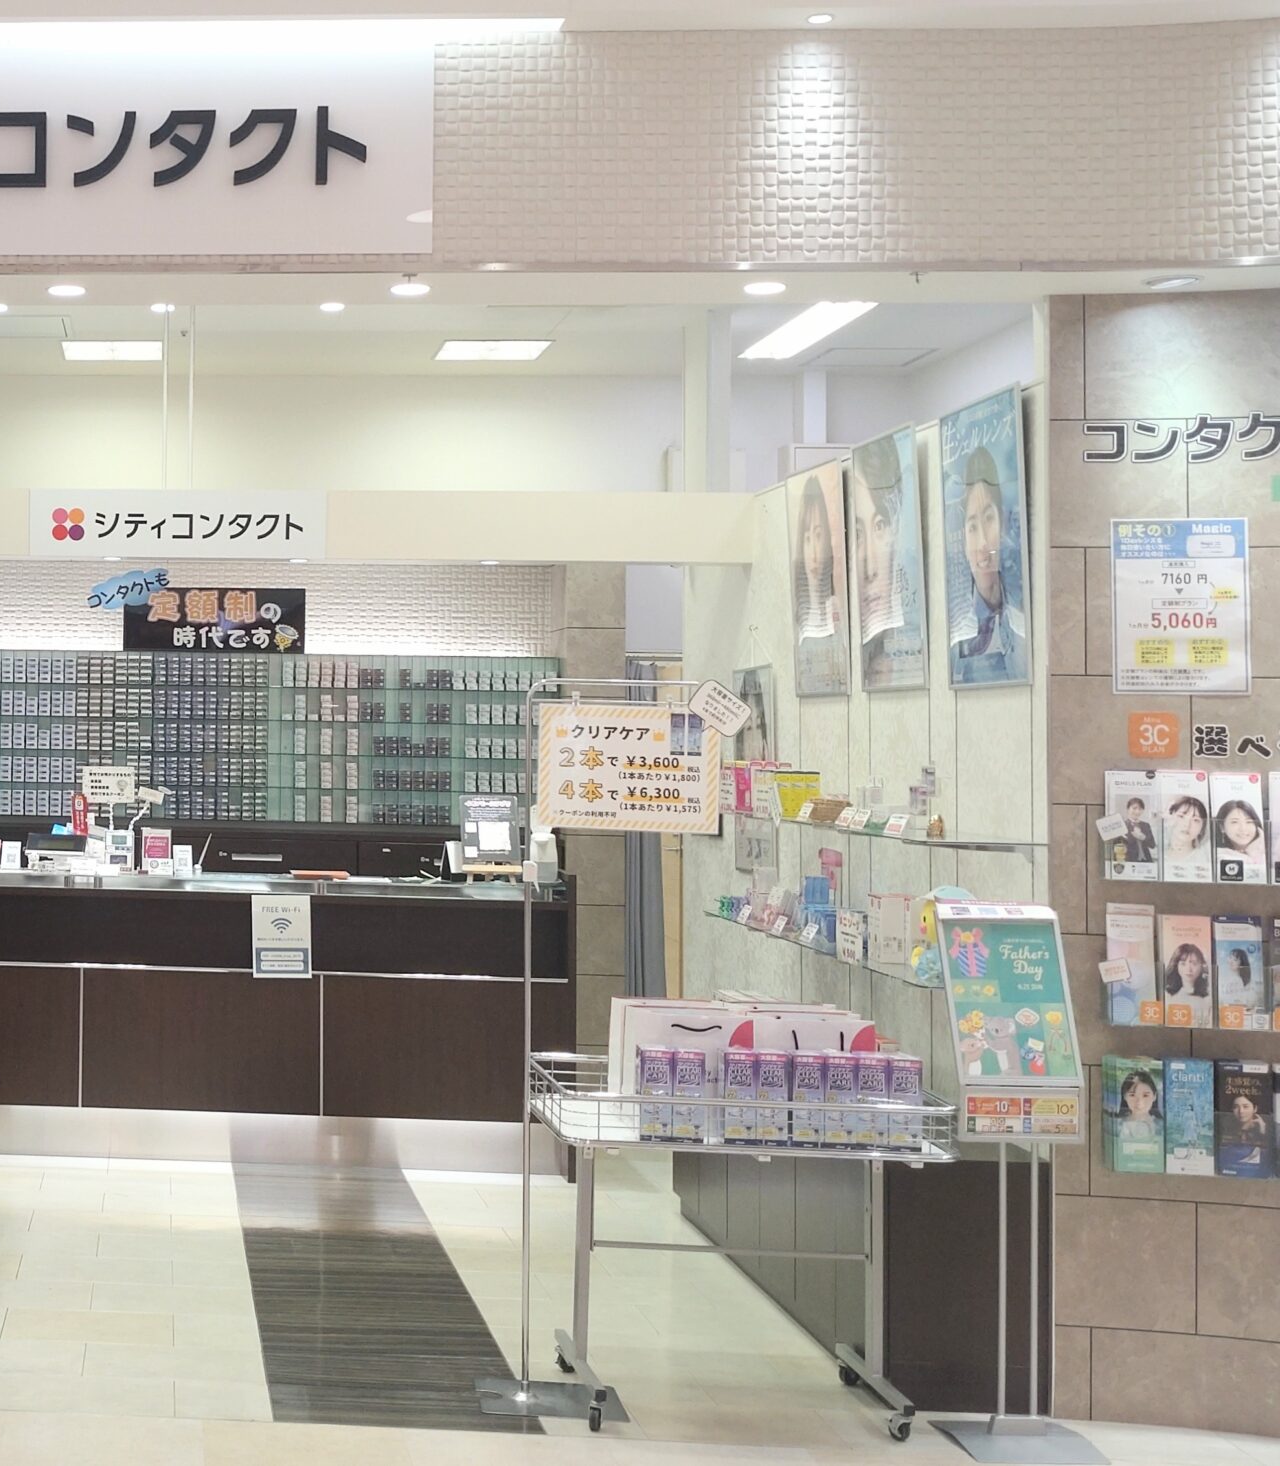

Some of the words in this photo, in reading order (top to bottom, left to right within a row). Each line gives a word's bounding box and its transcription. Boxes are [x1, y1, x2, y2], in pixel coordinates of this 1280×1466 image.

[1083, 411, 1280, 463] コンタク
[94, 512, 303, 540] シティコンタクト
[1191, 523, 1232, 533] Magic
[1161, 573, 1191, 584] 7160
[1197, 573, 1207, 584] 円
[87, 572, 170, 608] コンタクトも
[147, 590, 282, 623] 定額制の
[1151, 612, 1217, 631] 5,060円
[172, 626, 271, 649] 時代です
[571, 724, 650, 740] クリアケア
[1139, 724, 1170, 746] 3C
[1193, 724, 1280, 758] 選べ
[626, 755, 680, 769] ¥3,600
[558, 779, 619, 802] 4本で
[627, 786, 680, 800] ¥6,300
[998, 943, 1050, 961] Father's
[1012, 959, 1044, 982] Day
[1144, 1007, 1160, 1018] 3C
[1172, 1010, 1188, 1021] 3C
[1224, 1011, 1240, 1023] 3C
